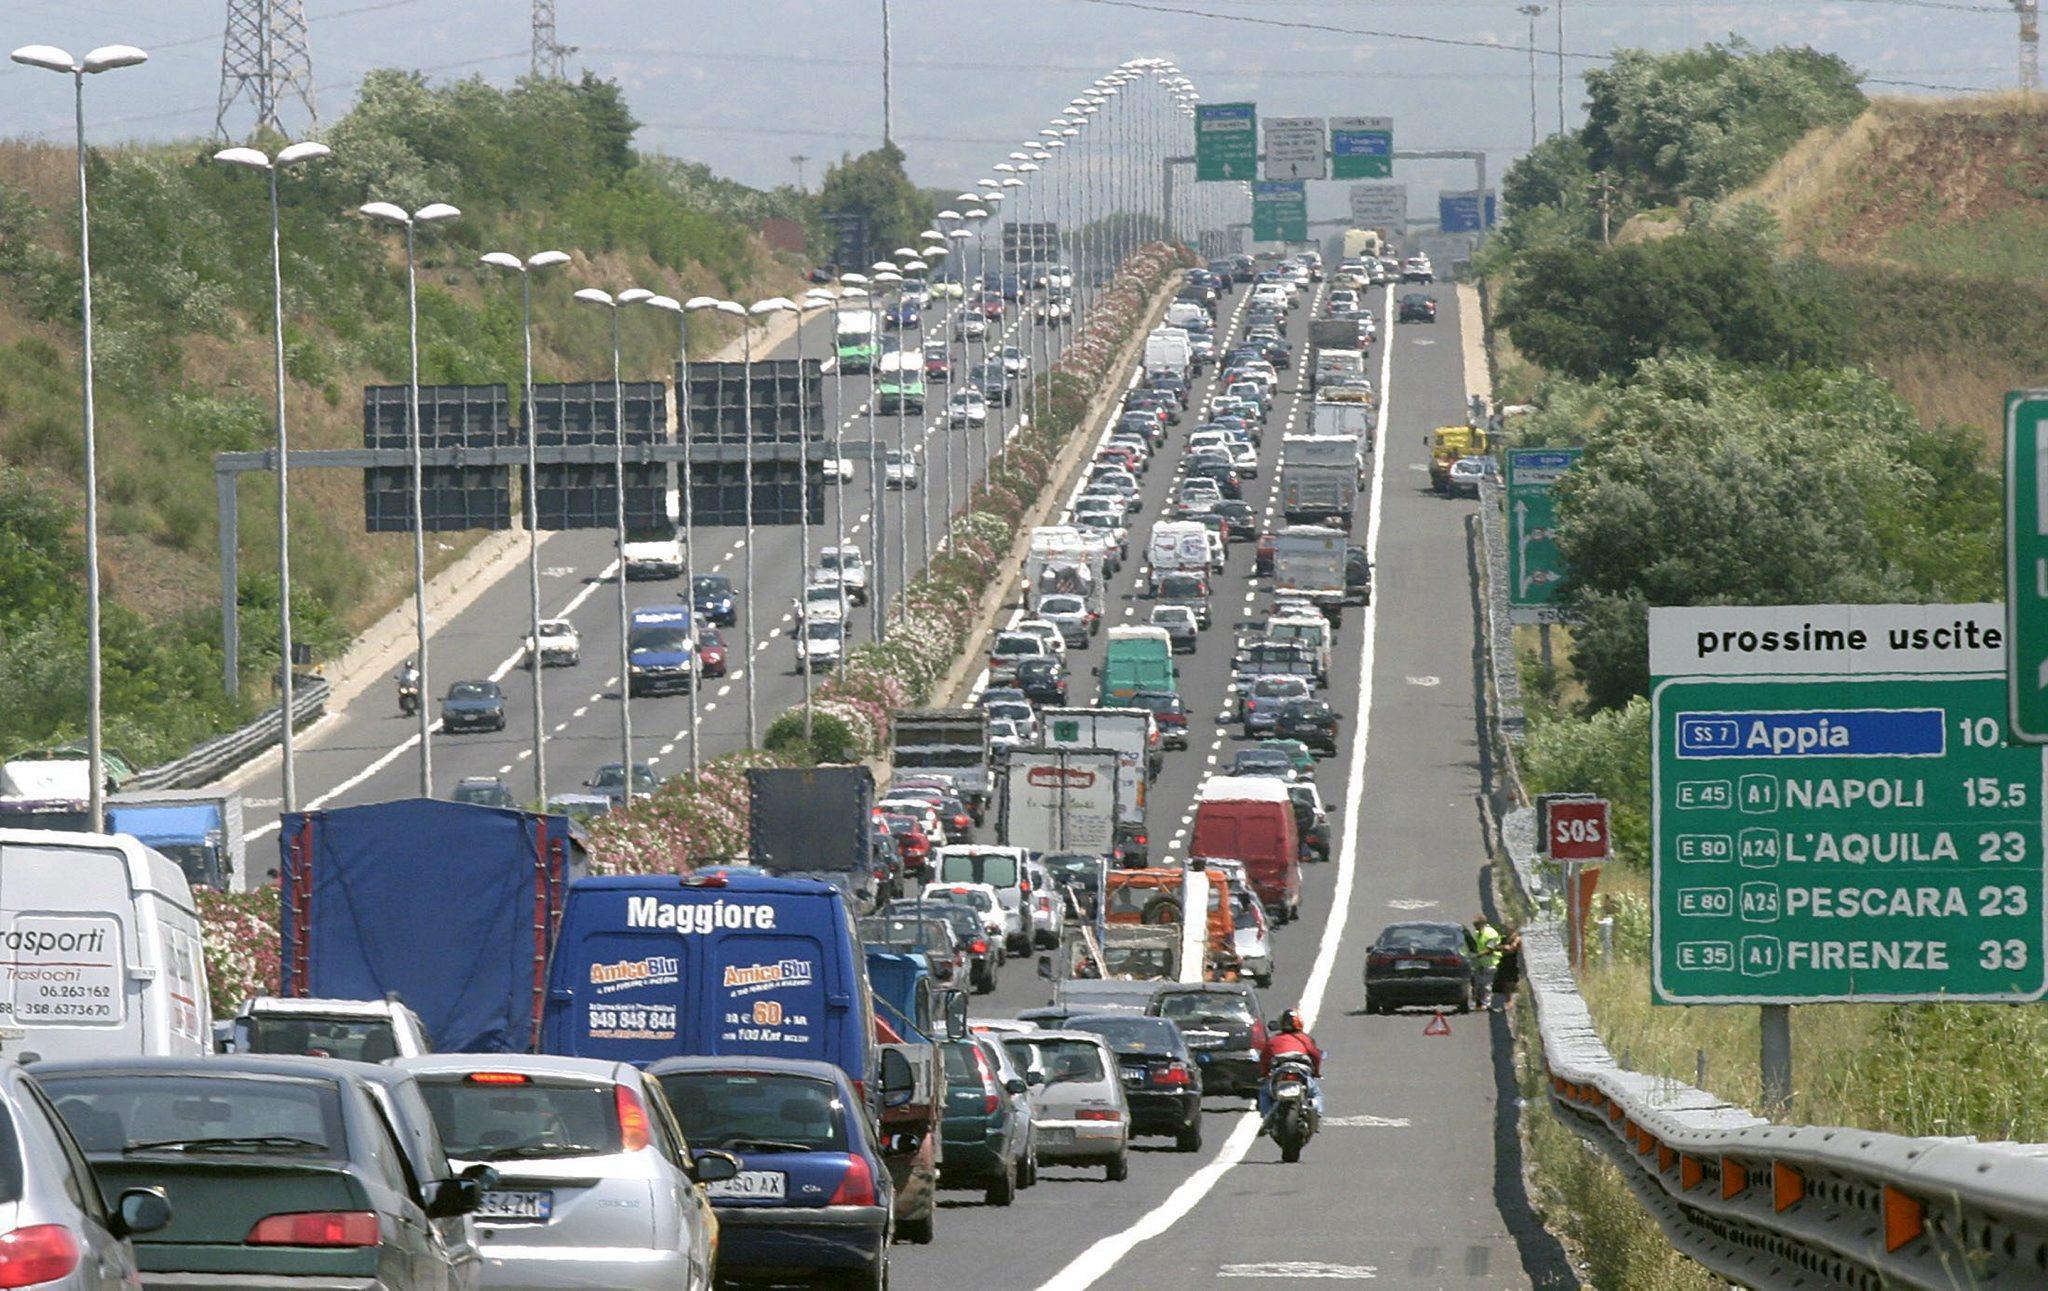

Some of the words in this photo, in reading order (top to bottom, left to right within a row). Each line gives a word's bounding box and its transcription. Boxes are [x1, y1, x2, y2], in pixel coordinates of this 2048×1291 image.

[1697, 623, 1867, 658] prossime
[1889, 621, 2003, 650] uscite
[1694, 727, 1713, 742] SS
[1720, 727, 1728, 742] 7
[1746, 718, 1850, 754] Appia
[1681, 787, 1695, 803] E
[1701, 787, 1725, 801] 45
[1748, 785, 1771, 804] A1
[1786, 779, 1924, 808] NAPOLI
[1557, 819, 1600, 843] SOS
[1682, 841, 1695, 856] E
[1701, 841, 1727, 856] 80
[1743, 839, 1777, 857] A24
[1786, 832, 1959, 864] L'AQUILA
[1979, 832, 2026, 862] 23
[627, 896, 775, 934] Maggiore
[1683, 894, 1696, 909] E
[1701, 894, 1727, 910] 80
[1743, 892, 1777, 911] A25
[1787, 887, 1969, 918] PESCARA
[1979, 886, 2028, 916] 23
[1682, 949, 1696, 964] E
[1702, 948, 1728, 964] 35
[1750, 947, 1772, 966] A1
[1787, 941, 1950, 970] FIRENZE
[1979, 939, 2028, 970] 33
[6, 967, 82, 981] Traslochi
[591, 956, 679, 984] AmicoBlu
[723, 959, 812, 987] AmicoBlu
[589, 1011, 617, 1029] 848
[649, 1012, 676, 1030] 844
[753, 1001, 782, 1026] 60
